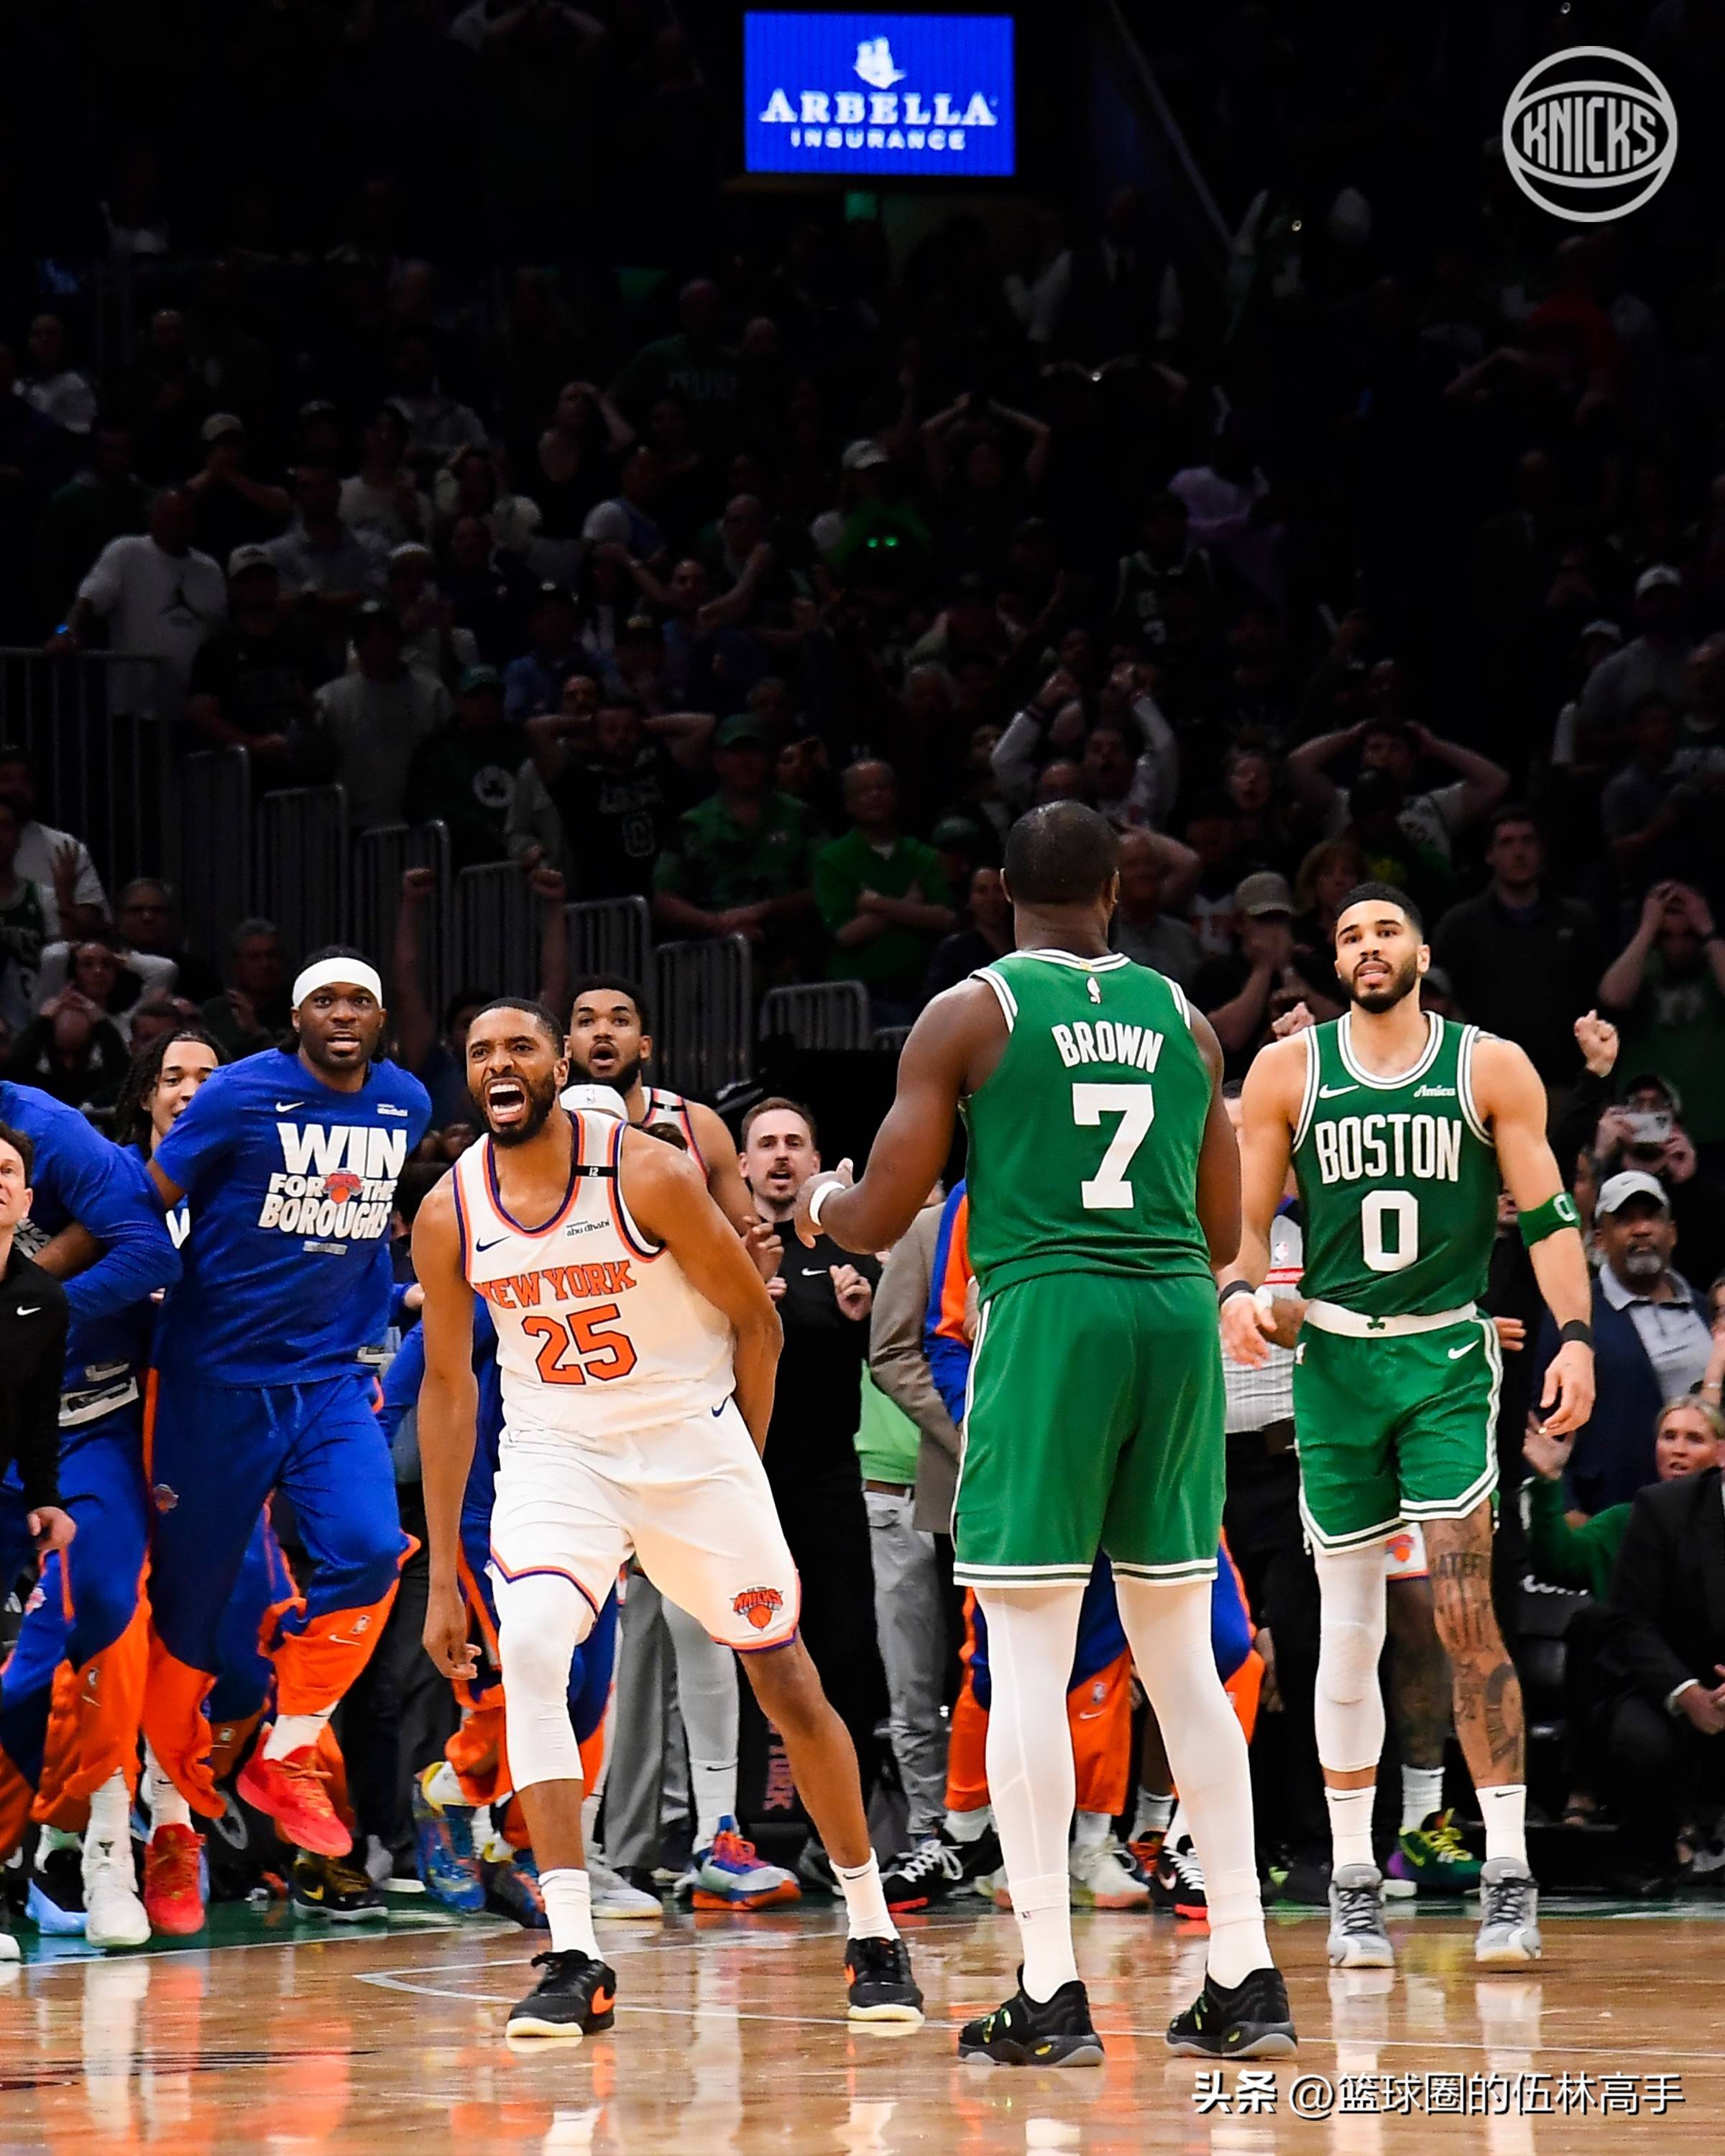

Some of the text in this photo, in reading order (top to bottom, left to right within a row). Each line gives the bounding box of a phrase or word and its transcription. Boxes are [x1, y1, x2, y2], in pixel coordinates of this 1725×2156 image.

[759, 88, 998, 126] ARBELLA
[791, 127, 966, 151] INSURANCE
[1051, 1021, 1164, 1074] BROWN
[1413, 1084, 1456, 1098] Amica
[276, 1122, 408, 1179] WIN
[1072, 1082, 1155, 1209] 7
[1314, 1113, 1462, 1184] BOSTON
[268, 1172, 325, 1198] FOR
[361, 1179, 398, 1202] THE
[589, 1166, 599, 1176] 12
[257, 1193, 393, 1240] BOROUGHS
[566, 1227, 584, 1237] abu
[584, 1219, 611, 1233] dhabi
[1361, 1189, 1419, 1272] 0
[543, 1259, 638, 1302] YORK
[521, 1302, 638, 1386] 25
